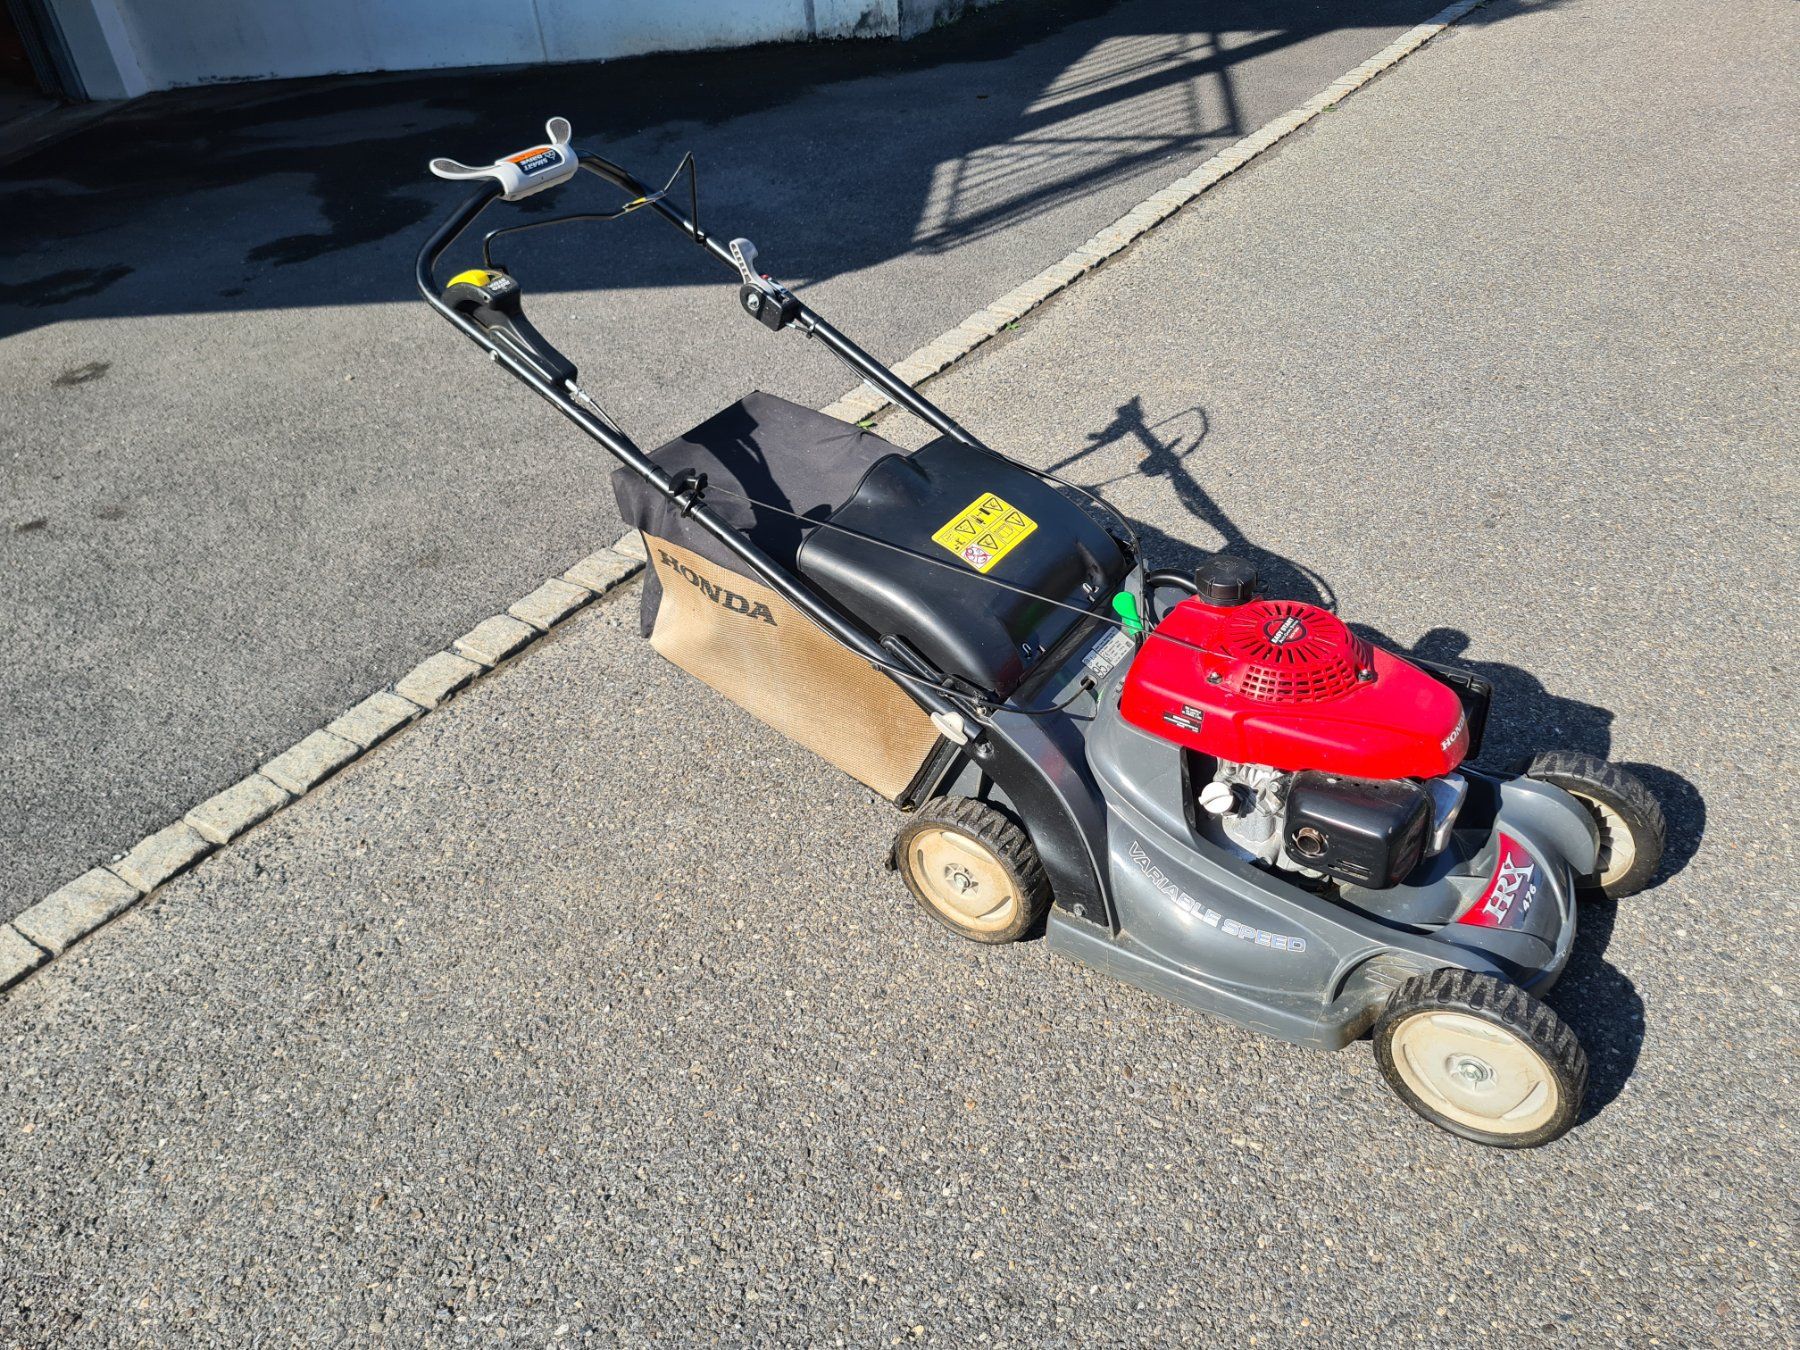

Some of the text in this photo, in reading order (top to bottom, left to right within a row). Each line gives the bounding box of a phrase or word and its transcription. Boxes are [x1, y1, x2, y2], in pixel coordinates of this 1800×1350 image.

[524, 158, 548, 171] SMART
[658, 549, 778, 626] HONDA
[1271, 629, 1284, 643] EASY
[1280, 617, 1294, 631] START
[1092, 662, 1108, 677] 95
[1129, 841, 1307, 953] VARIABLE SPEED
[1482, 851, 1535, 925] HRX
[1523, 883, 1537, 912] 476
